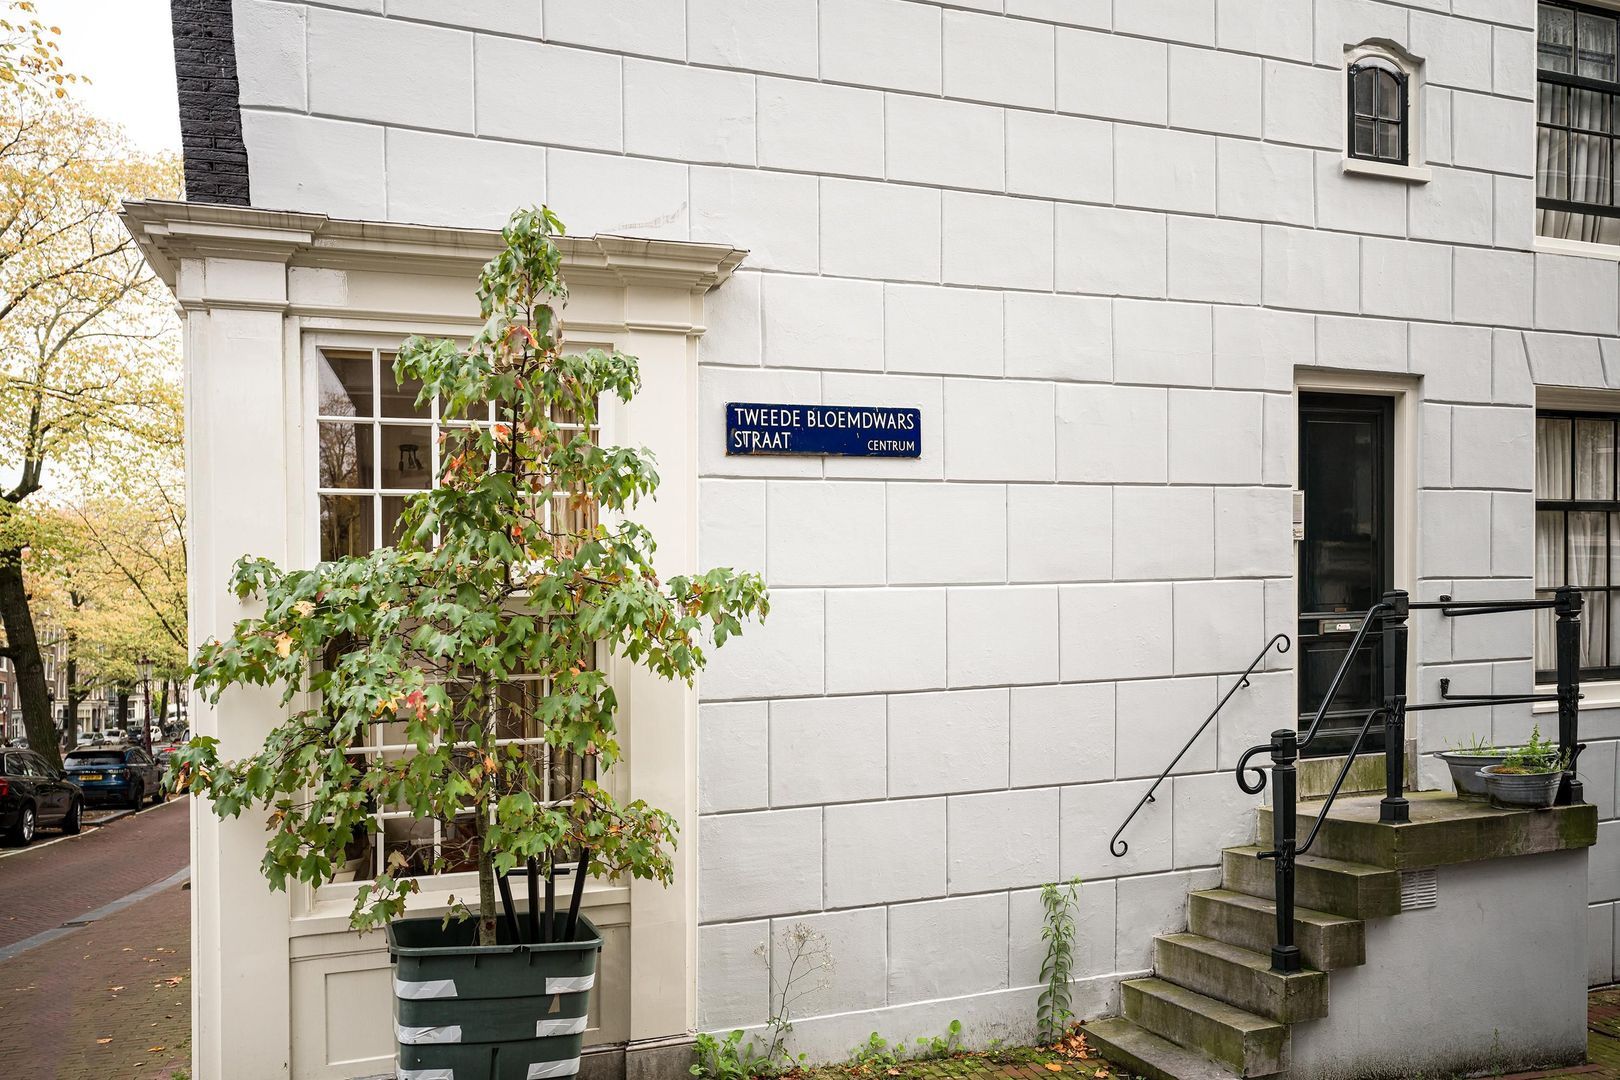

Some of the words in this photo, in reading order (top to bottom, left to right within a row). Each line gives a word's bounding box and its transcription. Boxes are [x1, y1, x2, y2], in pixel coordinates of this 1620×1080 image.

[734, 408, 800, 427] TWEEDE
[807, 411, 915, 430] BLOEMDWARS
[734, 431, 791, 449] STRAAT
[867, 439, 915, 451] CENTRUM
